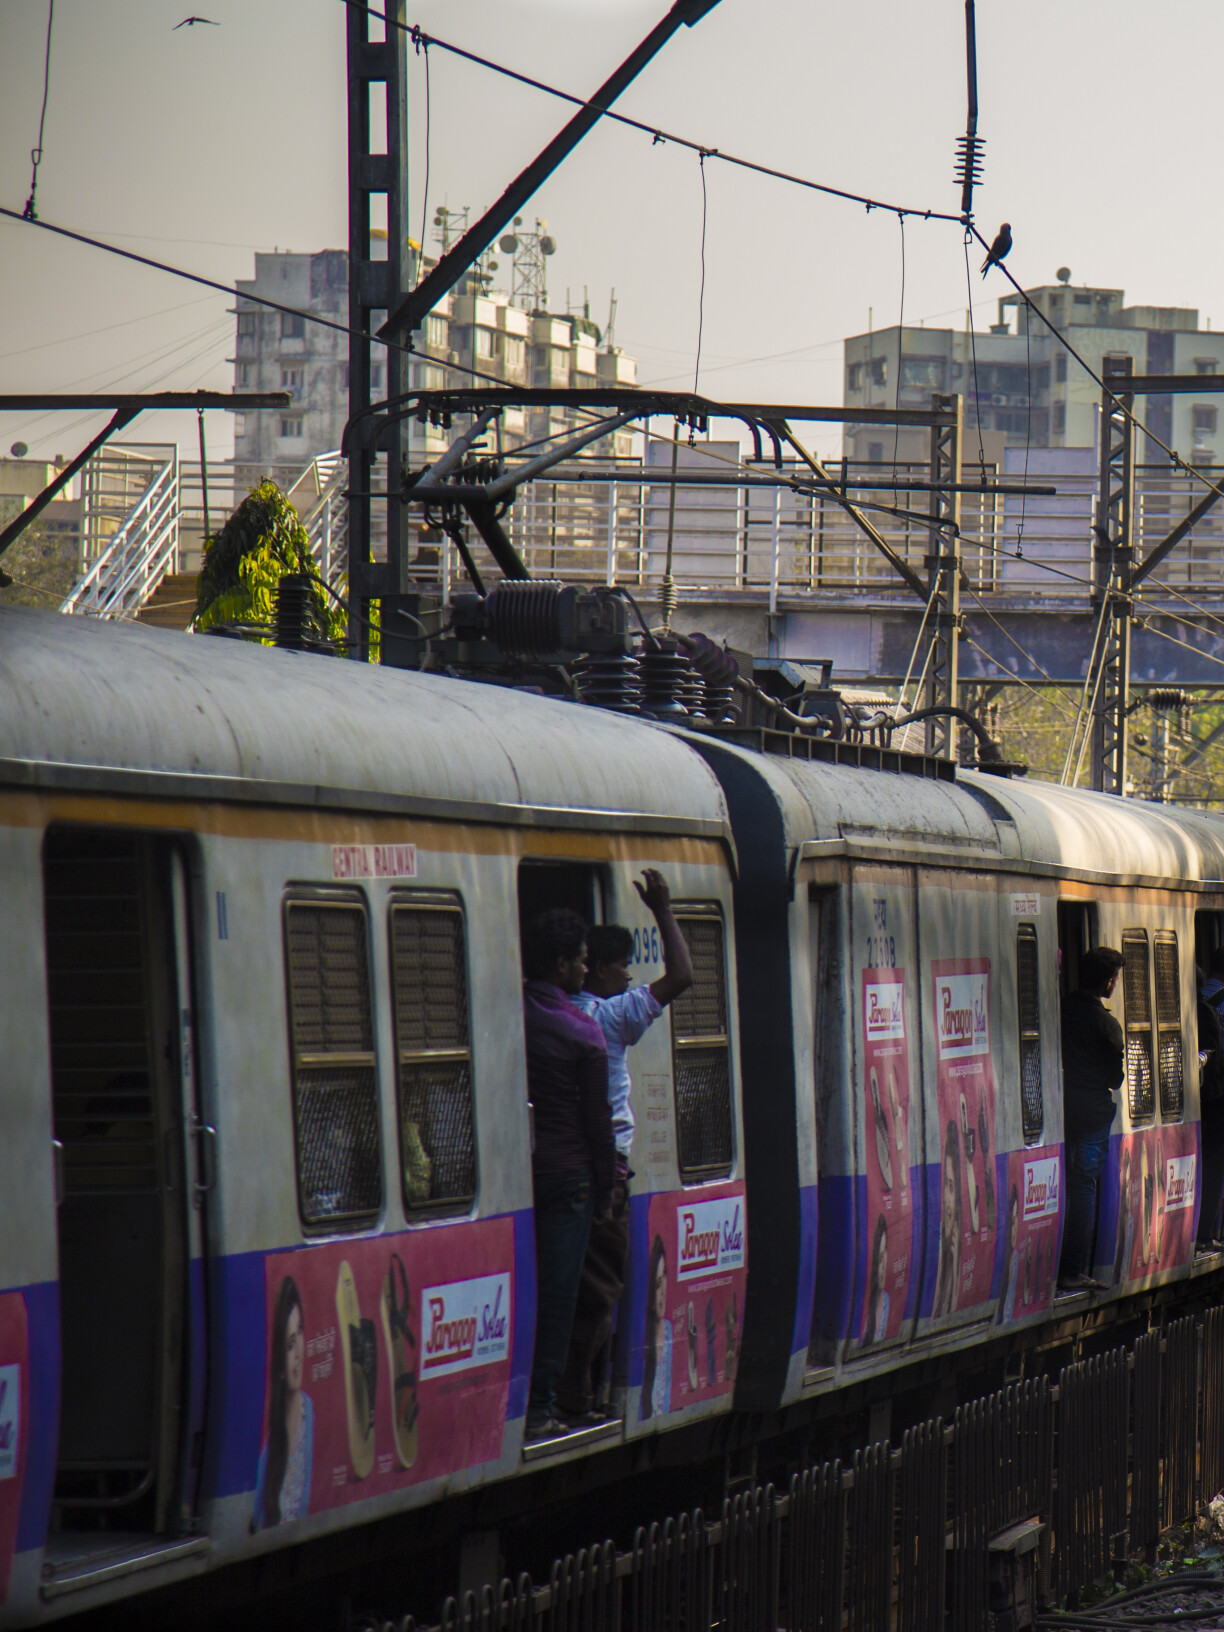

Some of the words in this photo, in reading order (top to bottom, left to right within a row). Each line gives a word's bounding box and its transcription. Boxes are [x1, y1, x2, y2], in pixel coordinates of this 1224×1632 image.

[941, 987, 973, 1039] Paragon
[681, 1212, 720, 1263] Paragon
[721, 1203, 743, 1253] Solea
[425, 1296, 477, 1358] Paragon
[478, 1284, 508, 1342] Solea
